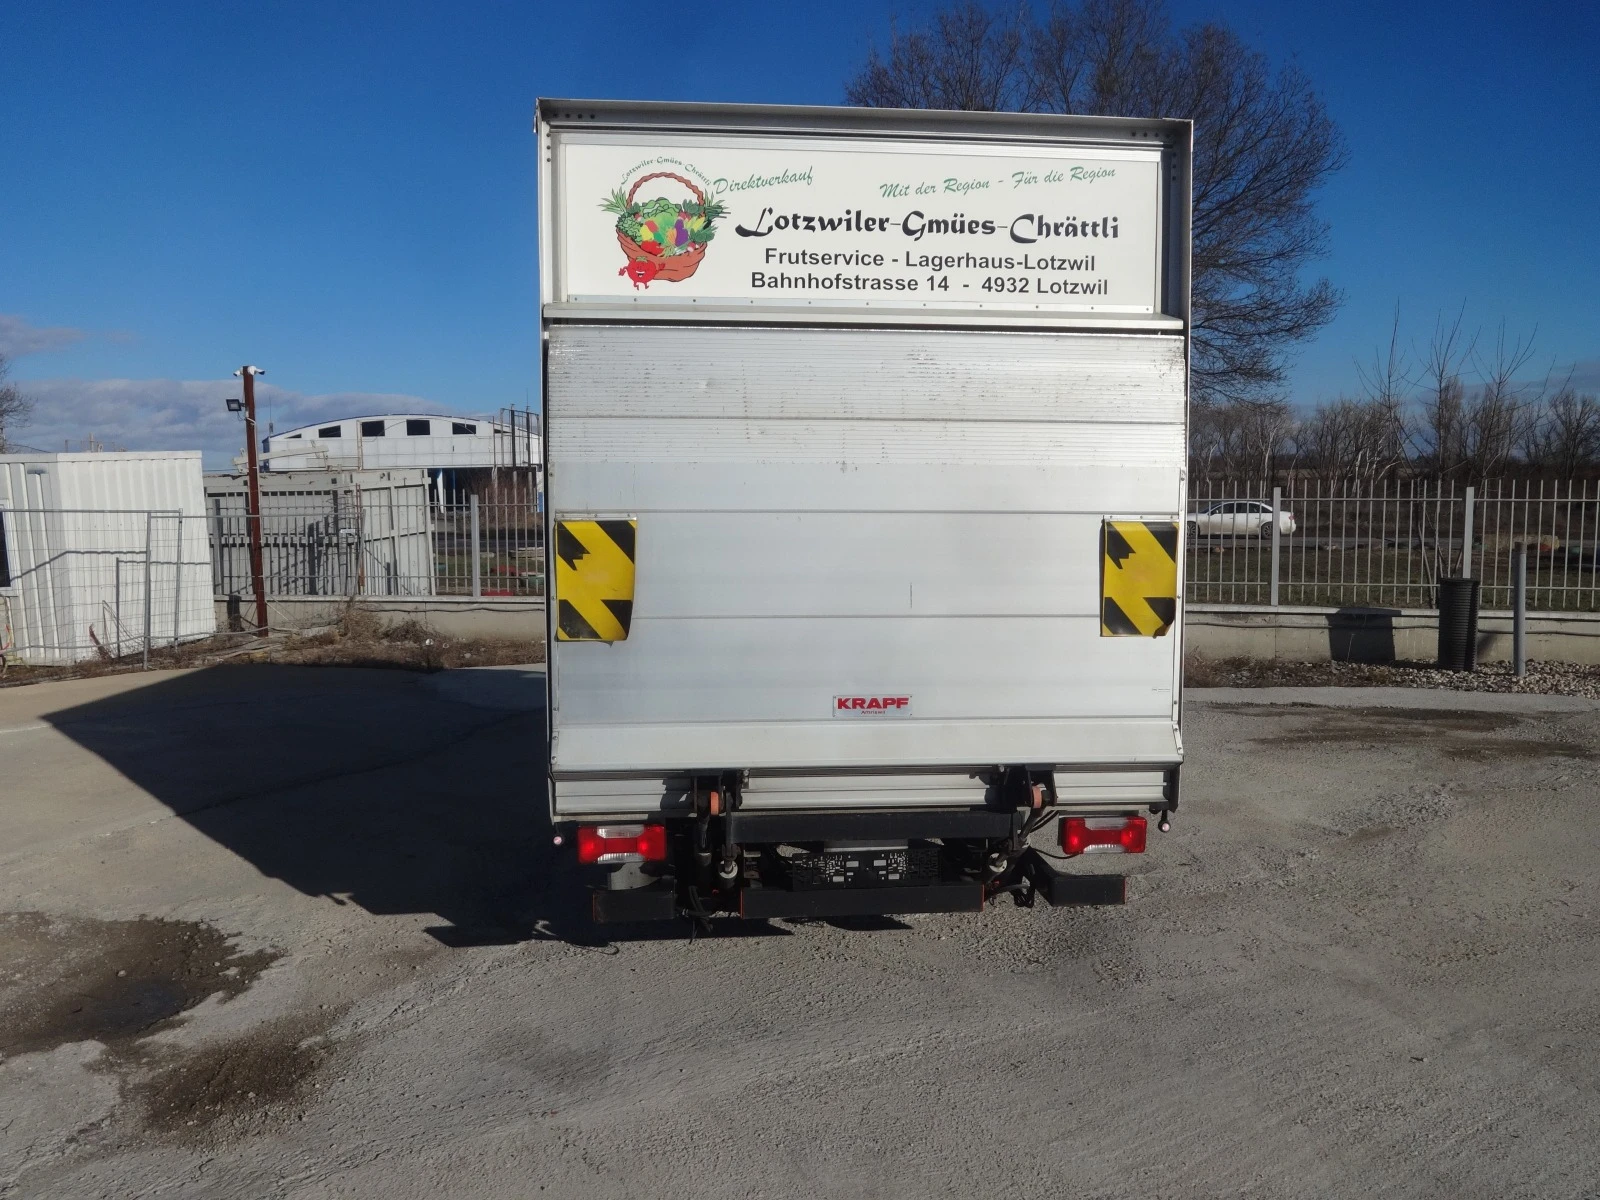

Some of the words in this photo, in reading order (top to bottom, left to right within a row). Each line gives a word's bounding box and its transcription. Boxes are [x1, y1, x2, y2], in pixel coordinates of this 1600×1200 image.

[713, 165, 813, 195] Direktverkauf
[879, 183, 910, 199] Mit
[914, 181, 937, 195] der
[943, 177, 990, 196] Region
[1011, 171, 1039, 190] Für
[1043, 169, 1064, 183] die
[1069, 165, 1117, 183] Region
[764, 247, 885, 267] Frutservice
[904, 250, 1095, 273] Lagerhaus-Lotzwil
[751, 271, 919, 292] Bahnhofstrasse
[926, 275, 950, 292] 14
[981, 276, 1030, 294] 4932
[1036, 276, 1108, 296] Lotzwil
[837, 697, 909, 709] KRAPF
